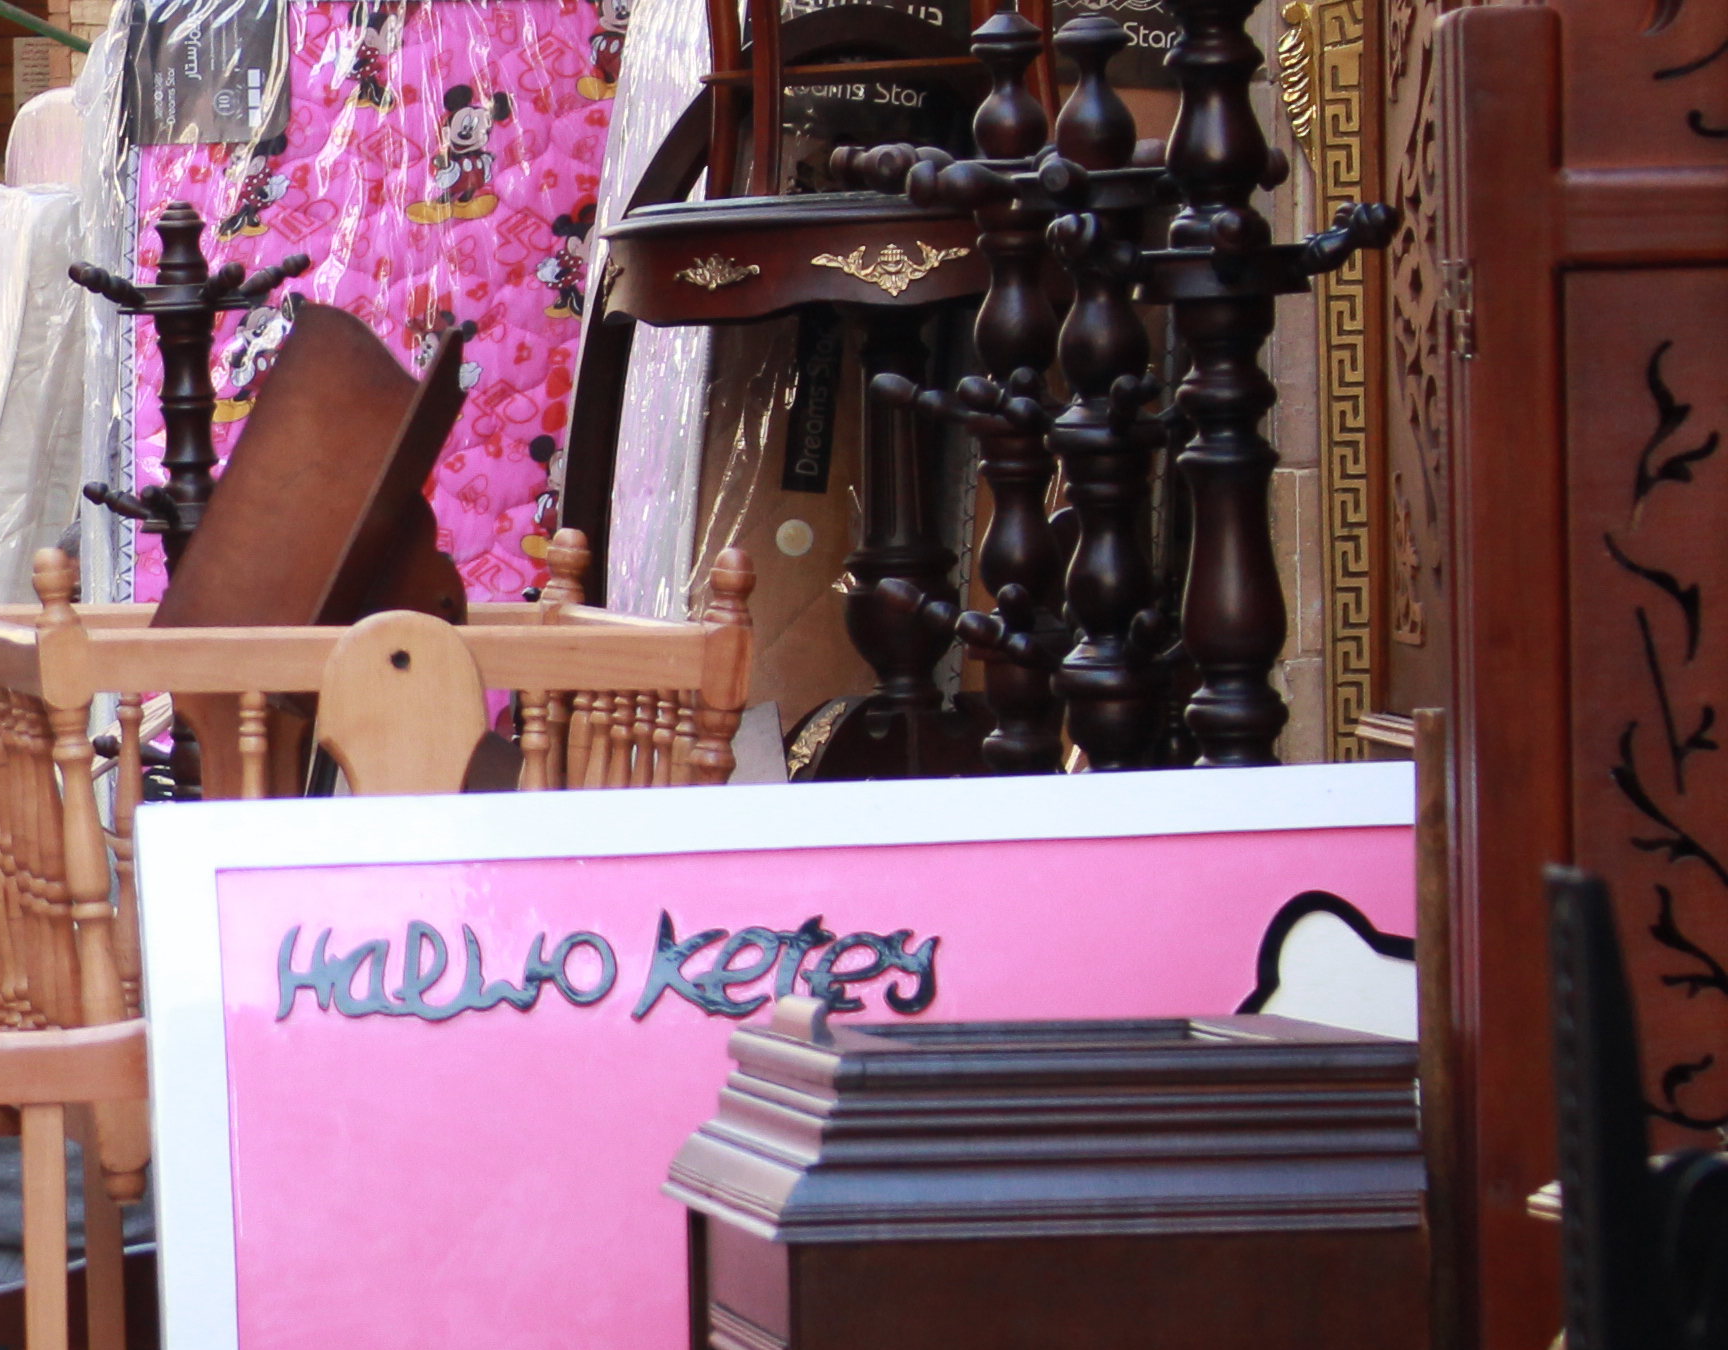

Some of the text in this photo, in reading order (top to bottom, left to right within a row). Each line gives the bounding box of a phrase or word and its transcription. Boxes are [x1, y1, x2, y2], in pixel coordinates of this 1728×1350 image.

[1123, 22, 1177, 49] Star
[874, 83, 928, 108] Star
[795, 386, 829, 476] Dreams
